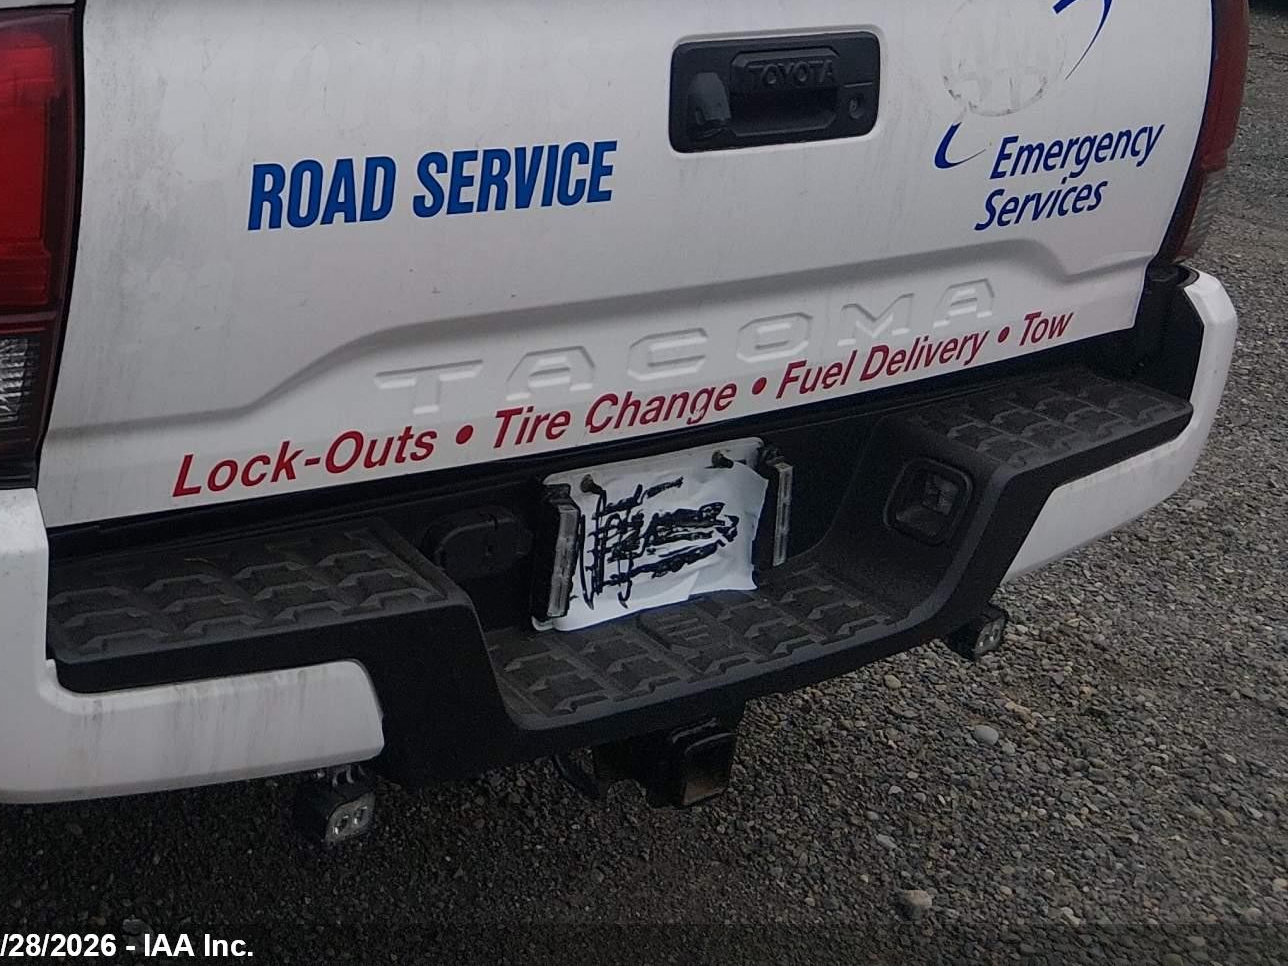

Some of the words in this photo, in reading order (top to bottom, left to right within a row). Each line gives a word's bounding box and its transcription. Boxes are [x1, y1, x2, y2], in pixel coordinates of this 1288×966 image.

[746, 58, 834, 87] TOYOTA
[247, 155, 397, 231] ROAD
[412, 140, 618, 218] SERVICE
[989, 124, 1166, 180] Emergency
[974, 176, 1108, 231] Services
[373, 277, 996, 417] TACOMA
[171, 424, 438, 499] Lock-Outs
[492, 405, 572, 450] Tire
[585, 379, 737, 435] Change
[776, 348, 858, 400] Fuel
[859, 327, 990, 381] Delivery
[1019, 310, 1074, 347] Tow
